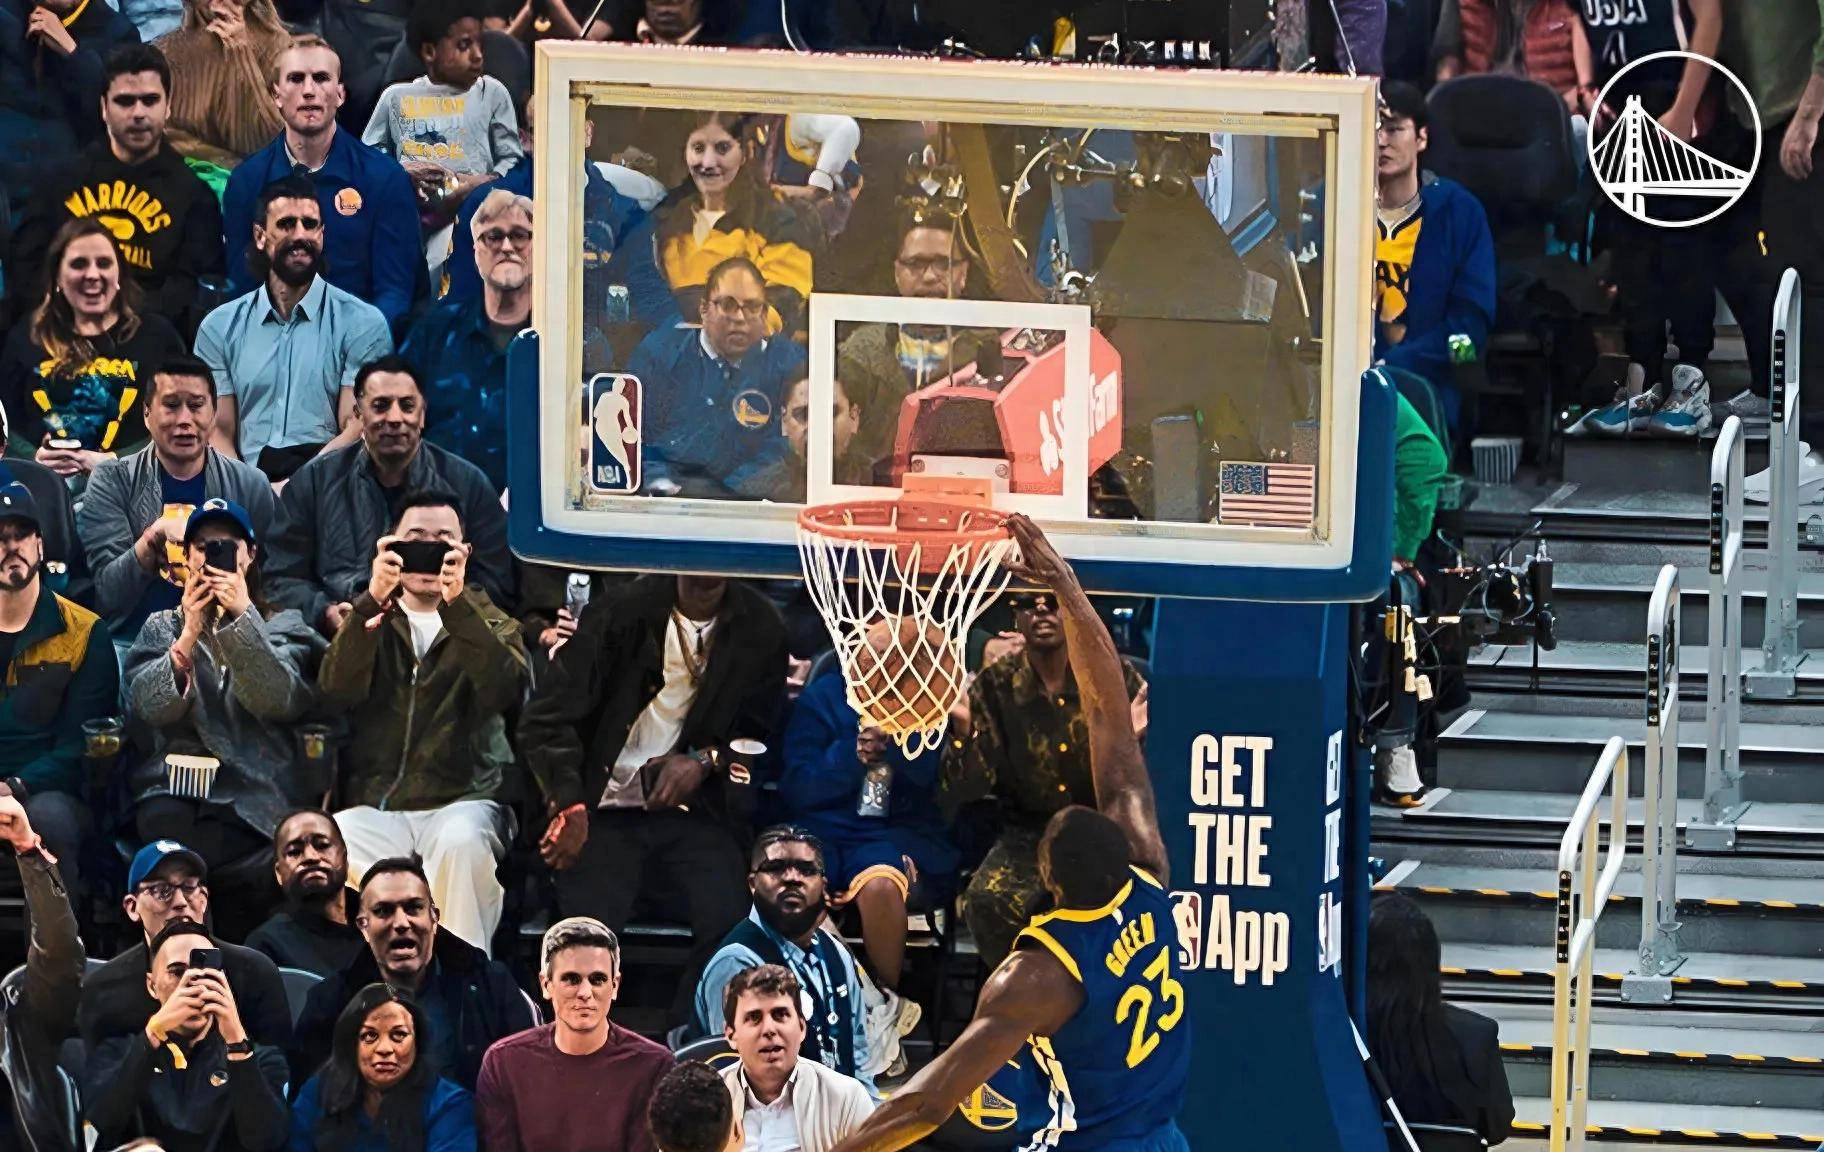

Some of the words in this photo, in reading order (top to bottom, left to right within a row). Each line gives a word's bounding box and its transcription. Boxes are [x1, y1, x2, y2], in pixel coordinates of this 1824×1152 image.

[64, 180, 171, 233] WARRIORS
[1190, 733, 1273, 807] GET
[1188, 812, 1272, 887] THE
[1105, 912, 1156, 977] GREEN
[1204, 894, 1289, 985] App
[1115, 945, 1184, 1069] 23
